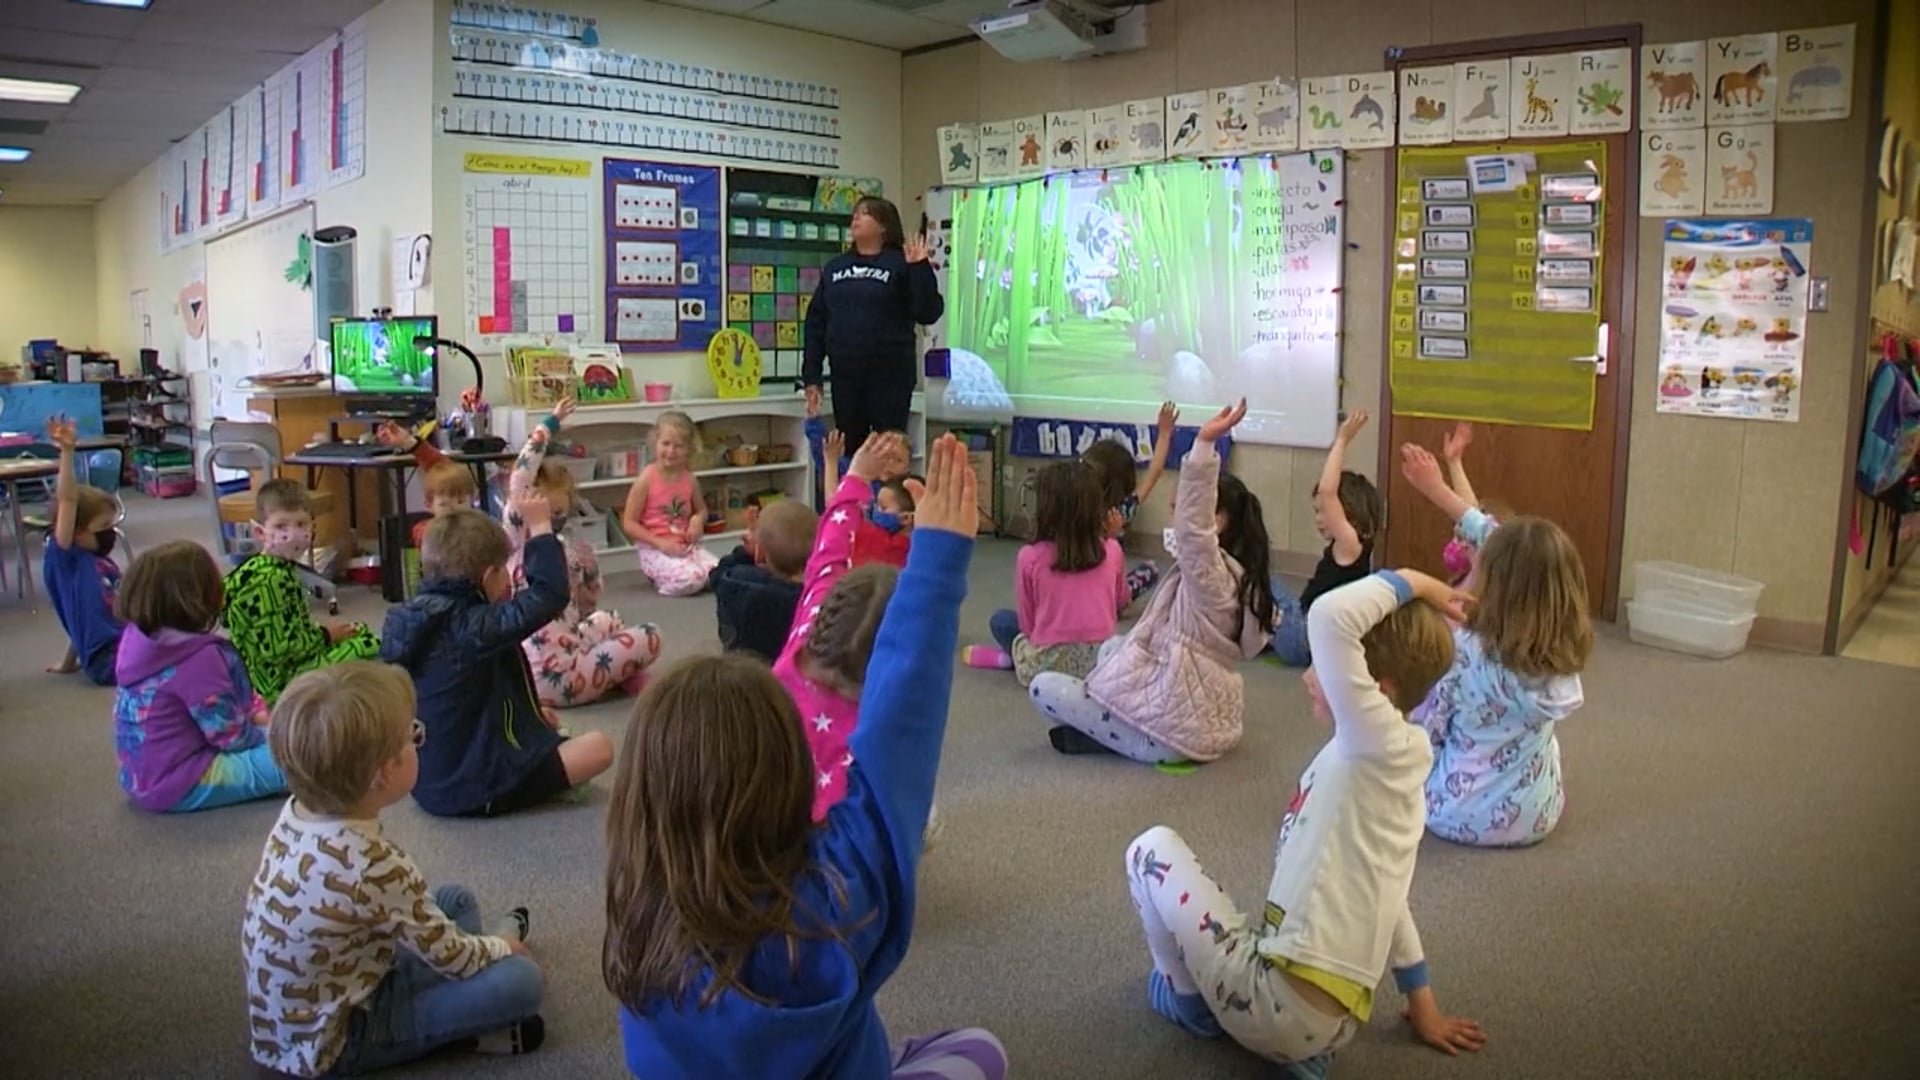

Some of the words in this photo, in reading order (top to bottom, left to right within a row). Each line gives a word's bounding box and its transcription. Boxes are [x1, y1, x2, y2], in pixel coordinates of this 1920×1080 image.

[1786, 34, 1800, 52] B
[1718, 42, 1731, 58] Y
[1652, 49, 1665, 64] V
[1522, 61, 1532, 76] J
[1581, 56, 1594, 71] R
[1466, 66, 1476, 80] F
[1349, 78, 1360, 93] D
[1407, 73, 1419, 87] N
[1260, 86, 1268, 97] T
[1308, 82, 1317, 95] L
[1218, 92, 1226, 104] P
[1172, 99, 1181, 111] U
[1127, 105, 1136, 117] E
[1052, 116, 1061, 127] A
[1092, 113, 1097, 124] I
[983, 126, 992, 137] M
[1017, 122, 1025, 133] O
[944, 130, 953, 141] S
[1717, 131, 1732, 149] G
[1648, 135, 1662, 151] C
[633, 167, 653, 182] Ten
[656, 171, 695, 185] Frames
[1256, 205, 1294, 222] oruga
[1520, 212, 1528, 223] 9
[1256, 223, 1325, 240] mariposa
[1520, 243, 1533, 253] 10
[466, 251, 475, 262] 5
[466, 267, 474, 278] 4
[1519, 267, 1529, 279] 11
[1256, 281, 1312, 305] hormiga
[1402, 292, 1409, 304] 5
[1515, 296, 1529, 307] 12
[1400, 318, 1408, 329] 6
[723, 337, 730, 345] 11
[717, 347, 726, 356] 10
[750, 345, 755, 353] 2
[1399, 344, 1407, 353] 7
[715, 357, 722, 367] 9
[754, 356, 760, 367] 3
[720, 368, 726, 379] 8
[753, 369, 758, 377] 4
[728, 377, 734, 387] 7
[738, 380, 744, 389] 6
[747, 376, 752, 386] 5
